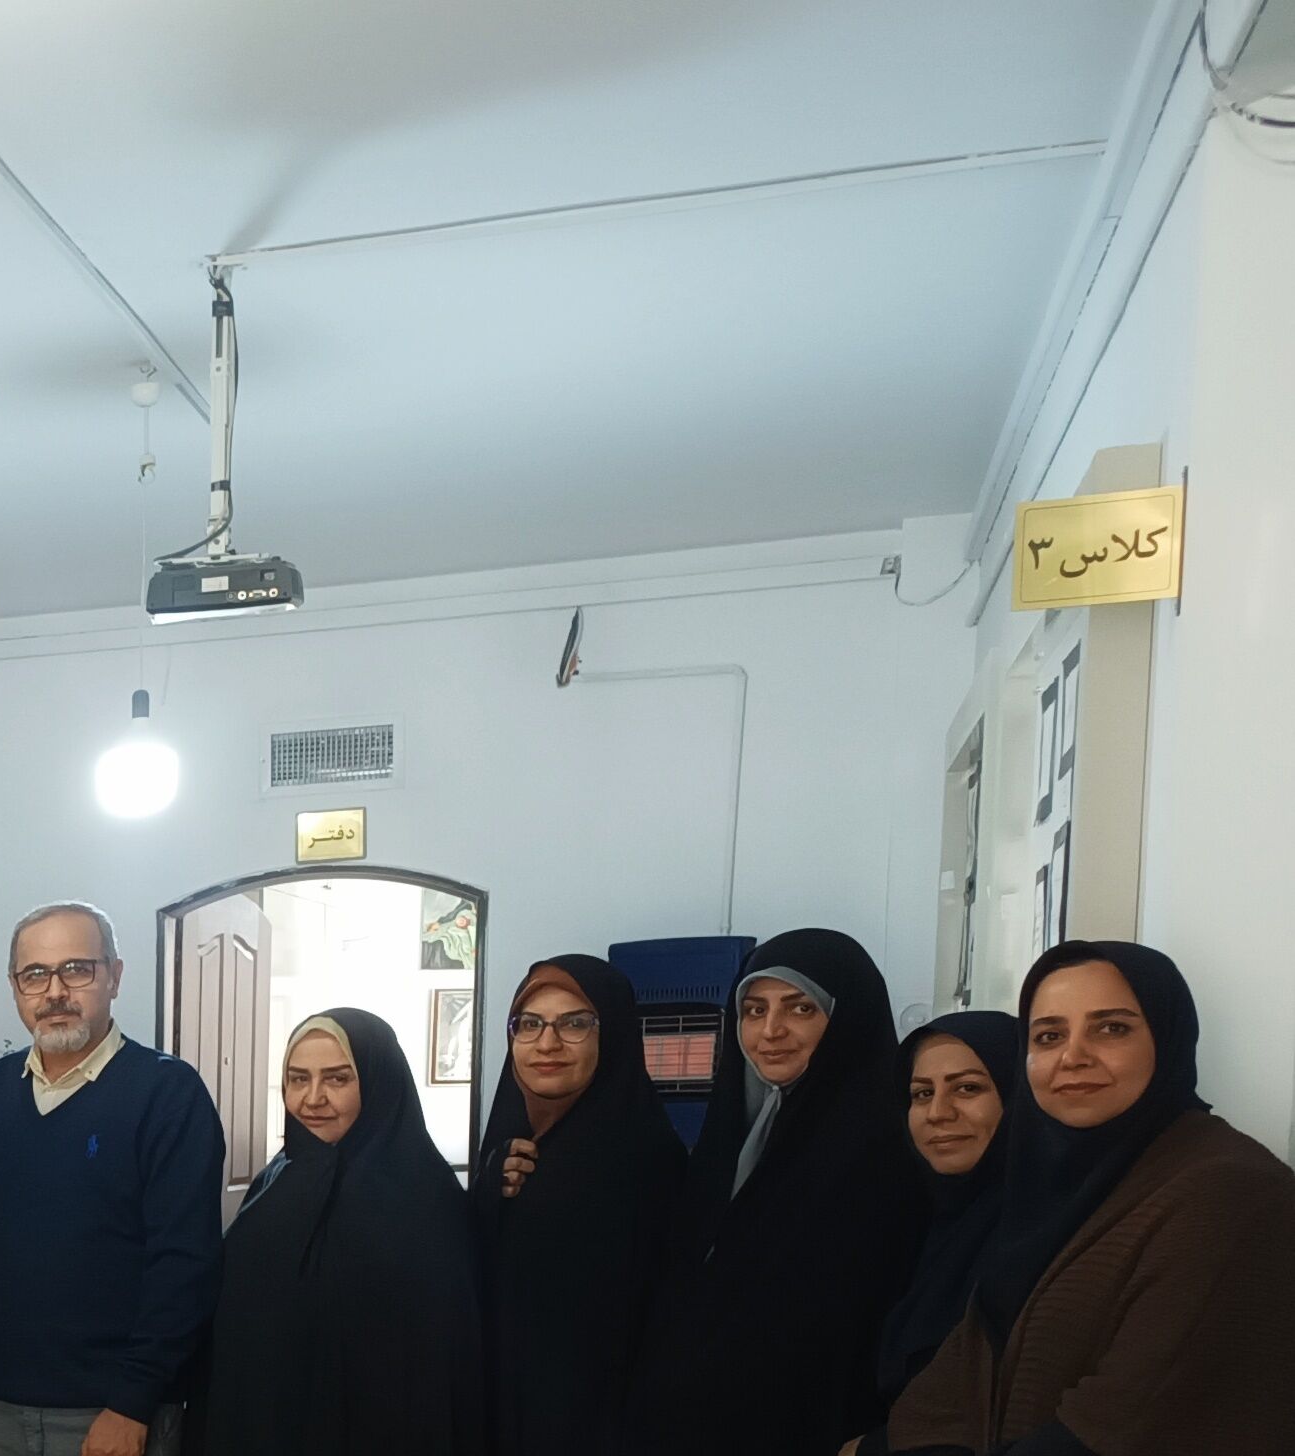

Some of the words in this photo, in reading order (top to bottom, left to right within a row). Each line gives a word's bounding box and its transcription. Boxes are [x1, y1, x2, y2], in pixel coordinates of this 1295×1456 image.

[1027, 536, 1054, 570] ۳
[1059, 526, 1168, 578] کلاس
[308, 825, 355, 848] دفتر
